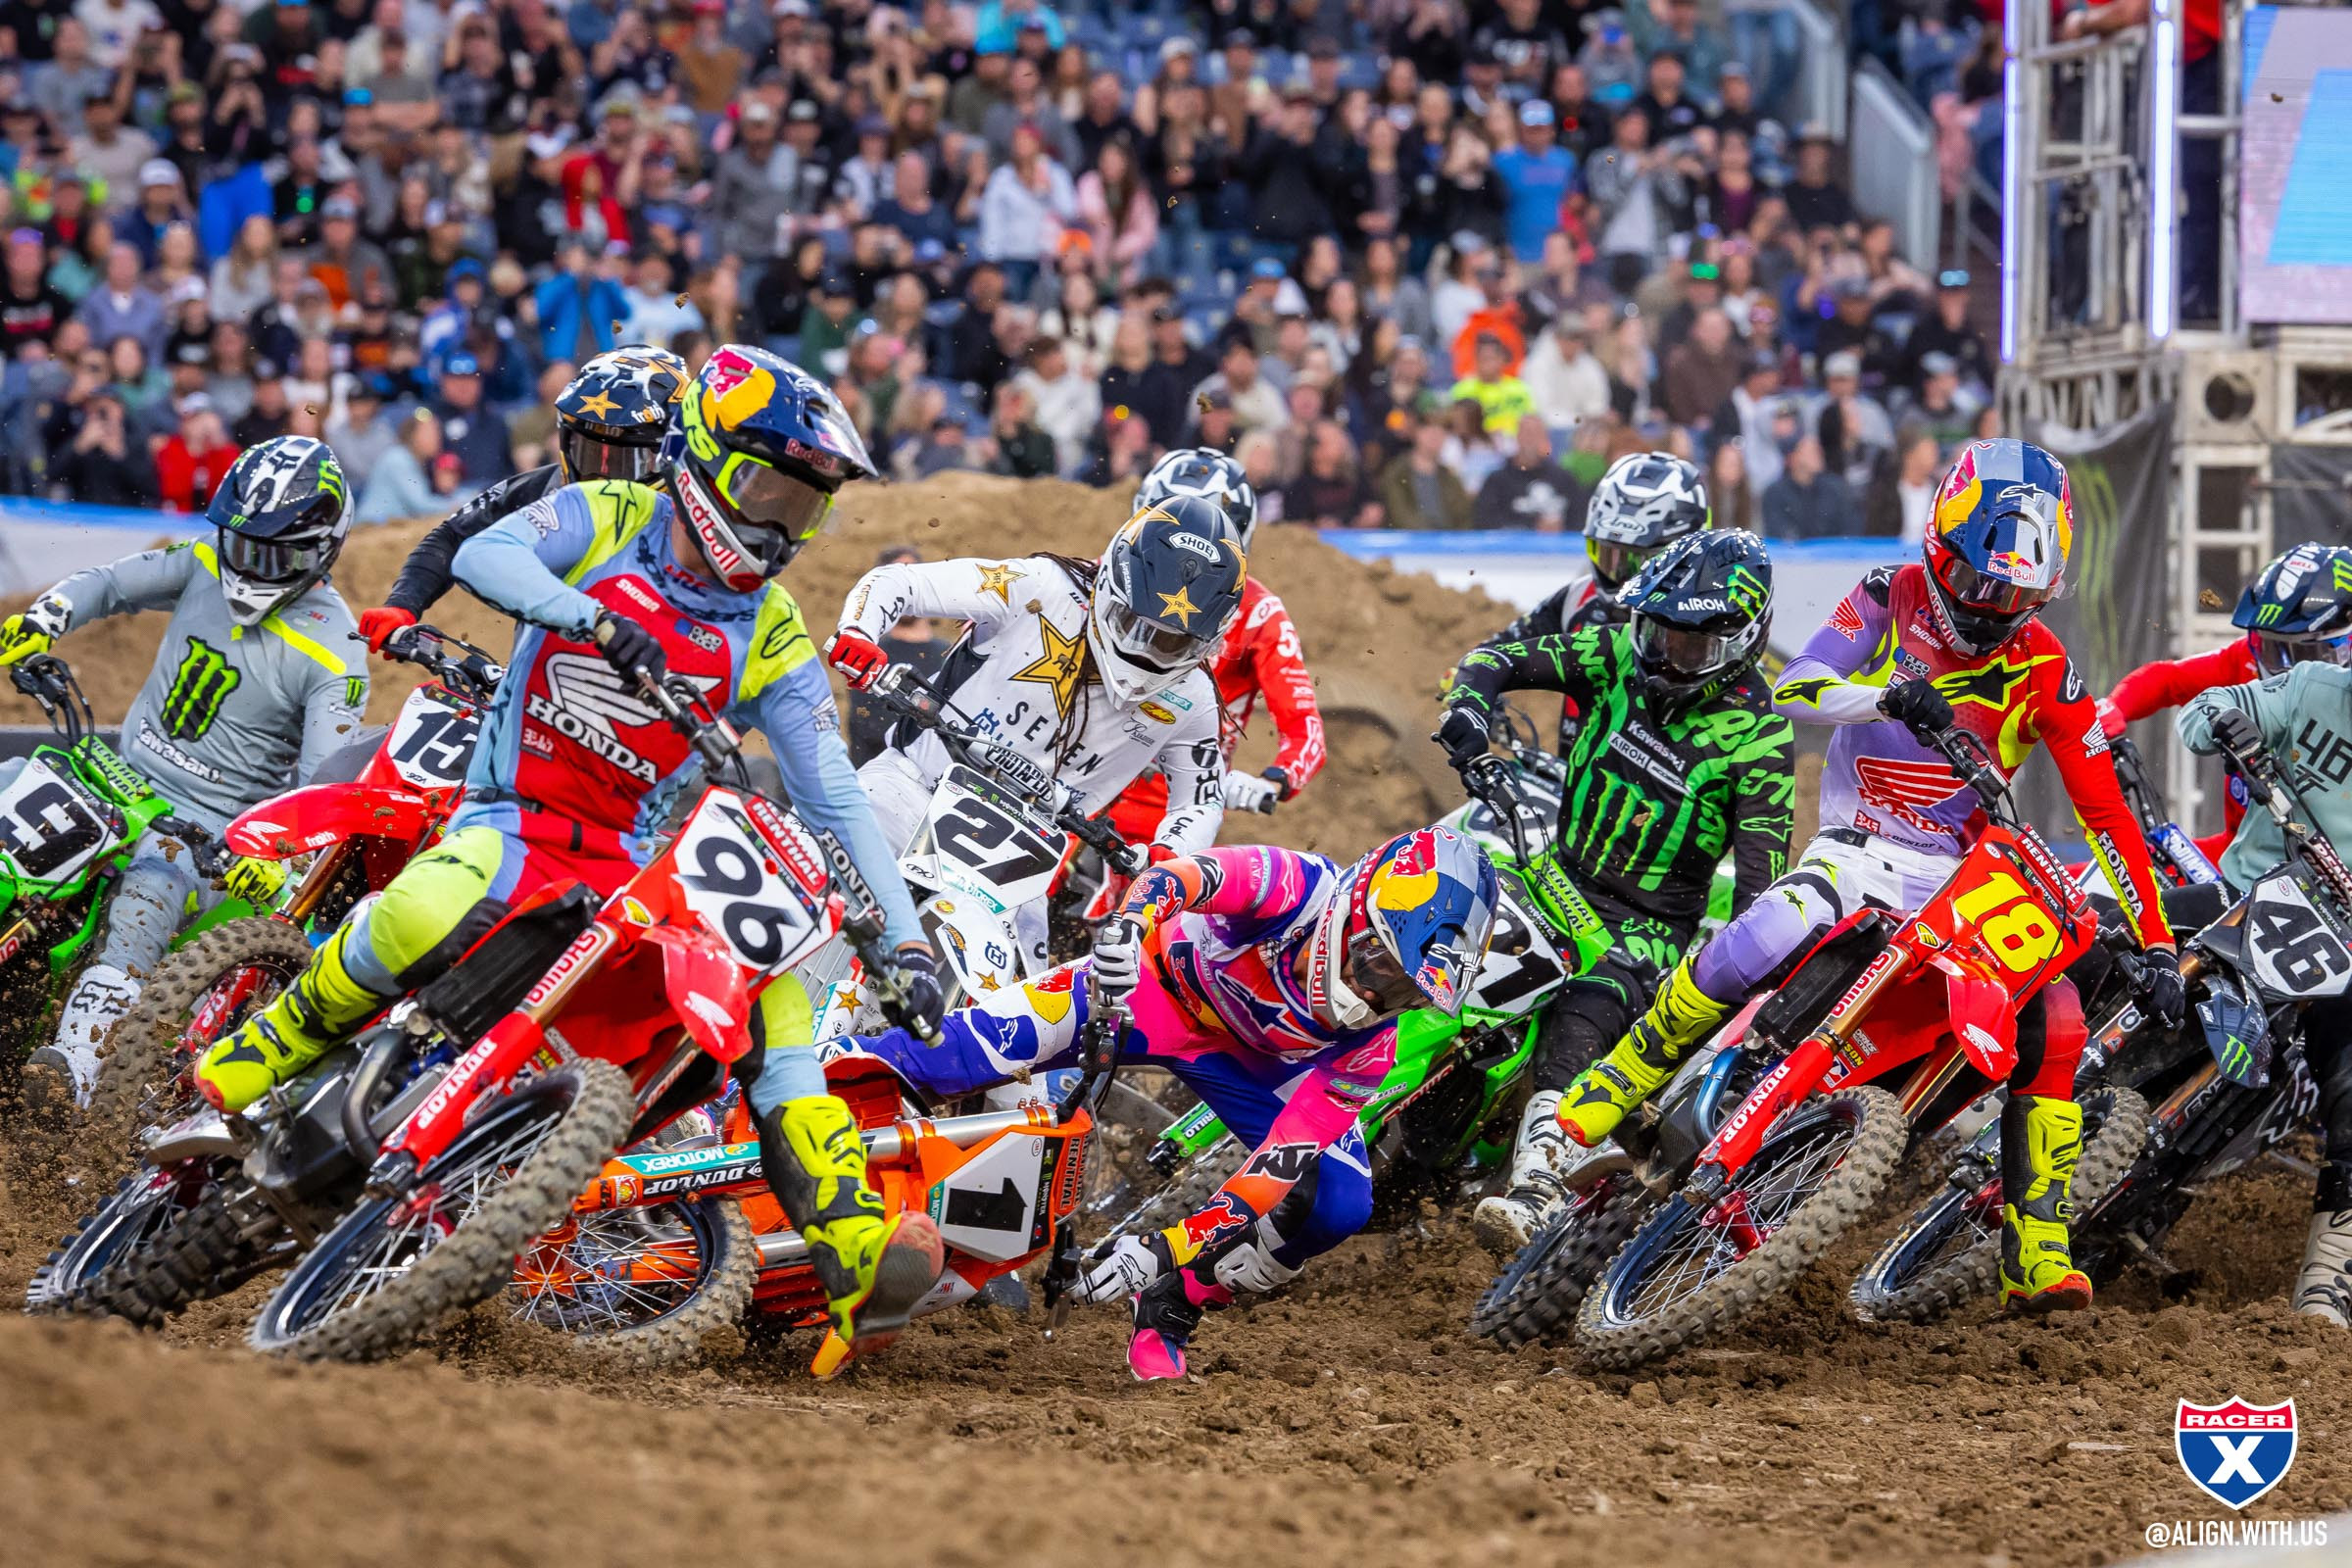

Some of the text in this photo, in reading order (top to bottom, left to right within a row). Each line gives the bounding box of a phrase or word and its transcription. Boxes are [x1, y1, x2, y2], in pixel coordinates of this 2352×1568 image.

[1179, 535, 1215, 558] SHOEI
[614, 576, 662, 613] SHOWA
[688, 634, 718, 654] LOCK
[693, 624, 724, 645] QUAD
[1905, 653, 1931, 672] QUAD
[1908, 623, 1944, 651] SHOWA
[1902, 660, 1928, 679] LOCK
[393, 710, 477, 782] 15
[525, 694, 658, 785] HONDA
[1610, 735, 1648, 766] AIROH
[1627, 719, 1687, 773] Kawasaki
[2085, 740, 2110, 759] HON
[2296, 717, 2352, 785] 46
[752, 803, 819, 888] RENTHAL
[933, 796, 1061, 891] 27
[1891, 834, 1938, 850] DUNLOP
[2030, 828, 2085, 896] RENTHAL
[817, 829, 886, 923] HONDA
[2021, 836, 2079, 906] RENTHAL
[2097, 830, 2144, 921] HONDA
[678, 836, 800, 966] 96
[1952, 871, 2064, 973] 18
[1974, 938, 2002, 969] HONDA
[2253, 900, 2351, 993] 46
[1961, 1029, 1994, 1073] HONDA
[416, 1036, 498, 1129] DUNLOP
[1722, 1061, 1792, 1144] DUNLOP
[640, 1147, 727, 1173] MOTOREX
[643, 1165, 748, 1196] DUNLOP
[1058, 1137, 1082, 1211] RENTHAL
[944, 1176, 1028, 1233] 1
